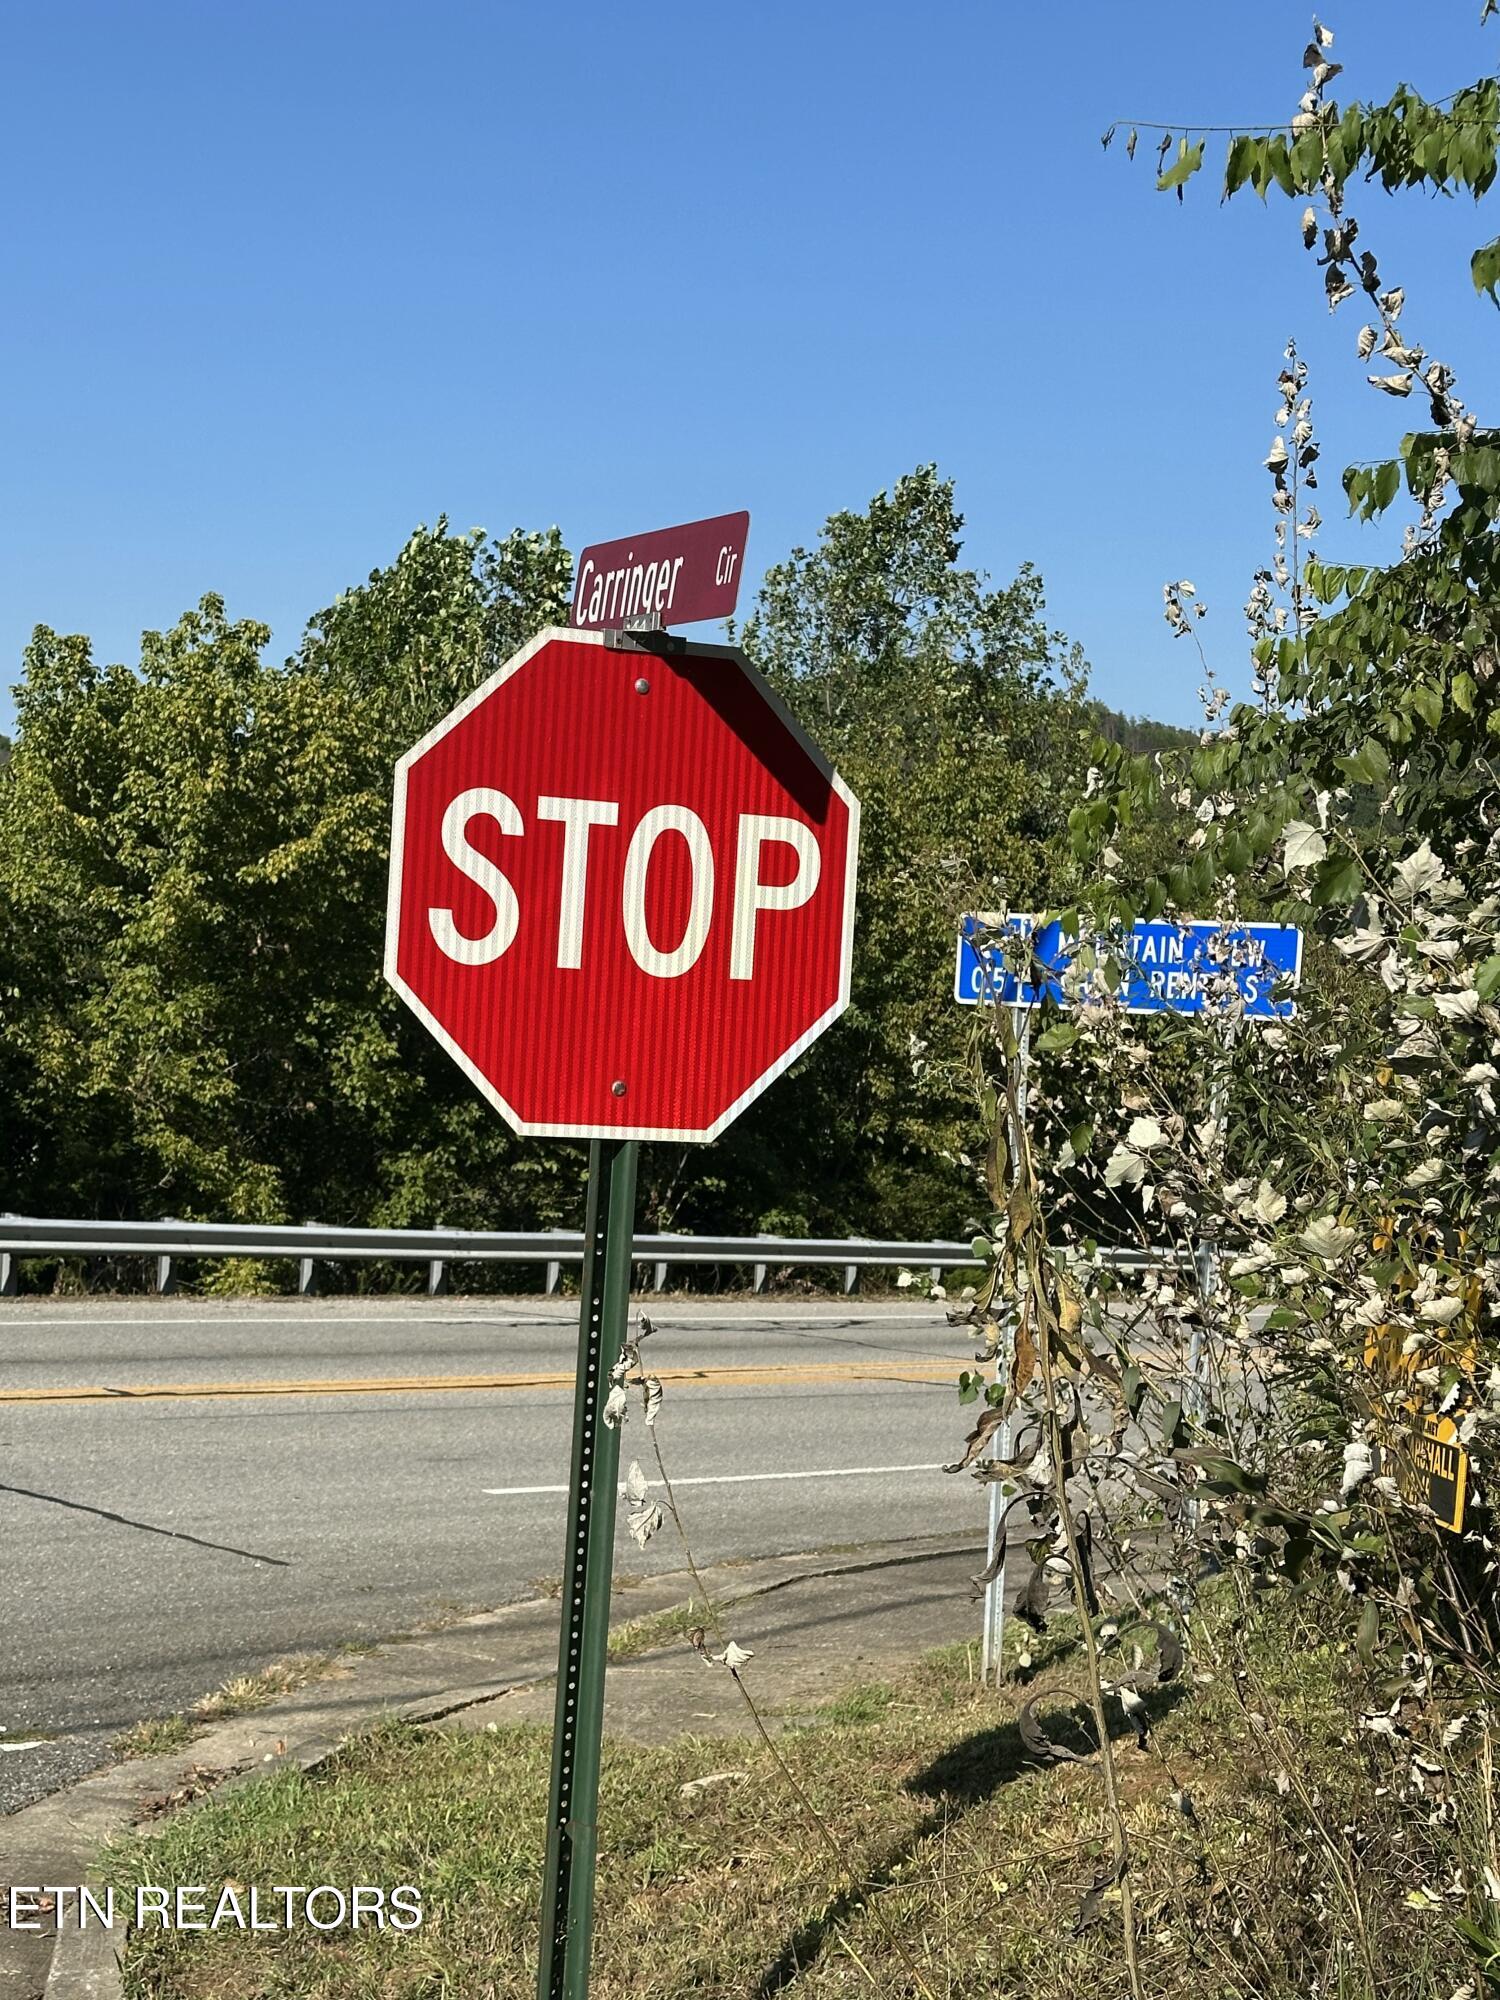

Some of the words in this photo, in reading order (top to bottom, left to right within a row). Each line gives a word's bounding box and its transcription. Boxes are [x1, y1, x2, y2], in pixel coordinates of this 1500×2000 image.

[576, 552, 684, 626] Carringer
[715, 546, 738, 586] Cir
[428, 787, 822, 980] STOP
